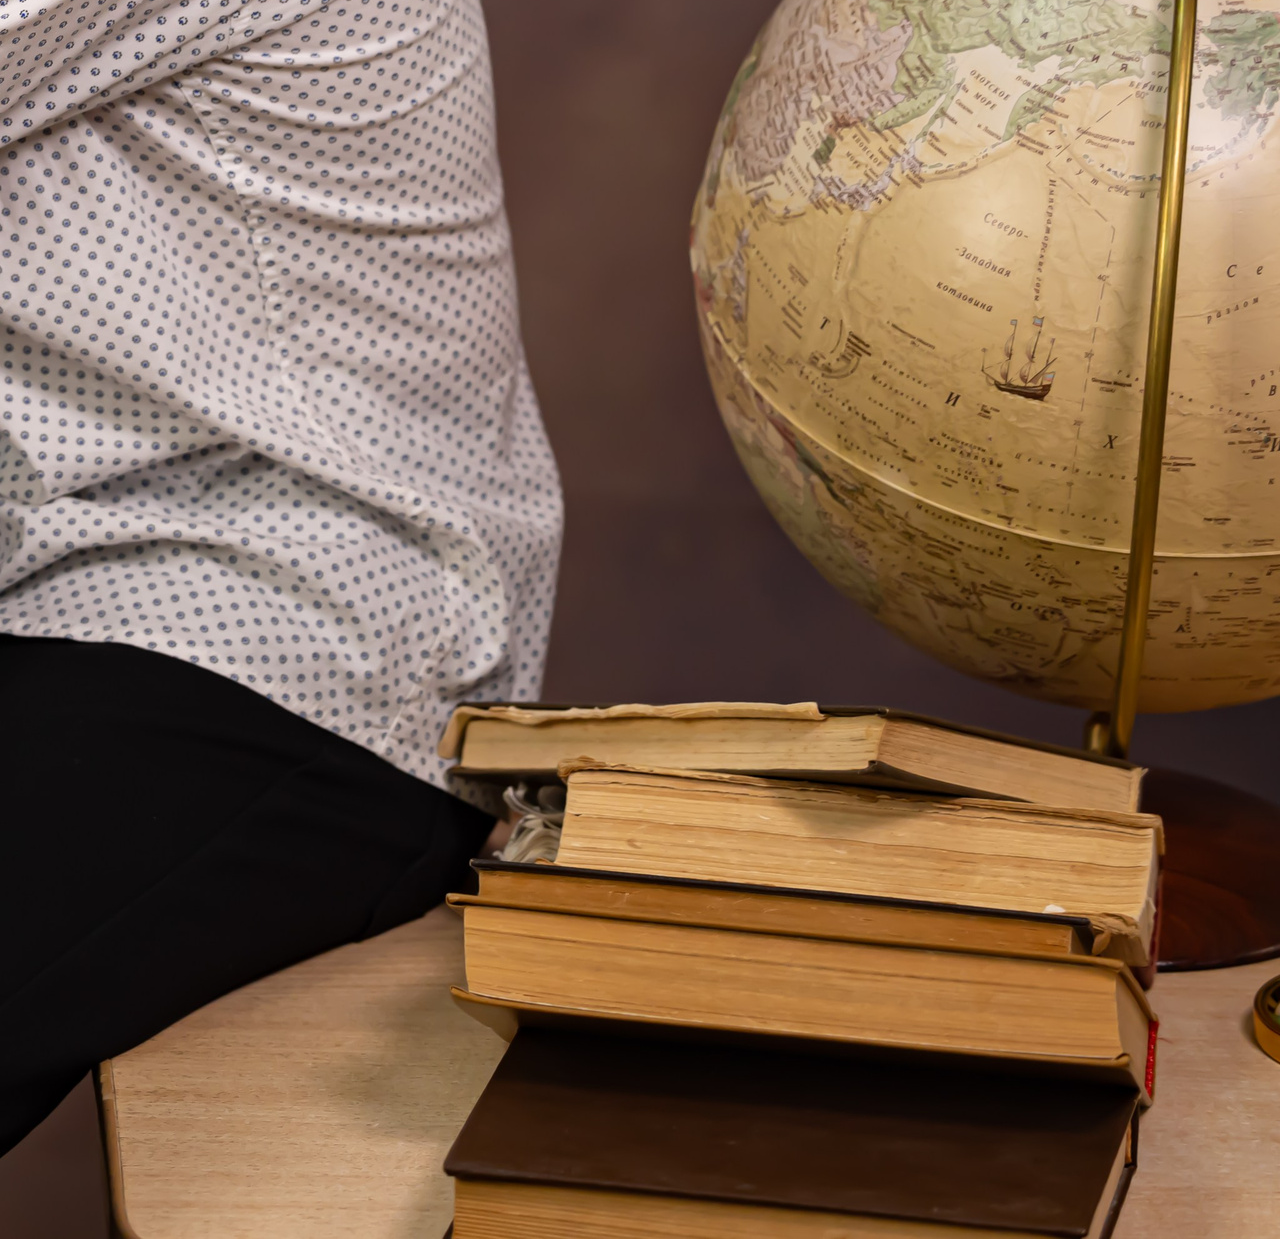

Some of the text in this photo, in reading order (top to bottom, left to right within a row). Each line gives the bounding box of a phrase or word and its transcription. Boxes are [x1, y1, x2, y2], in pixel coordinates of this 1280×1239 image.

[970, 69, 1011, 102] ОХОТСКОЕ
[973, 92, 997, 110] МОРЕ
[983, 212, 1029, 239] Северо-
[955, 246, 1012, 278] -Западная
[936, 281, 994, 312] котловина
[1206, 296, 1260, 324] разлом
